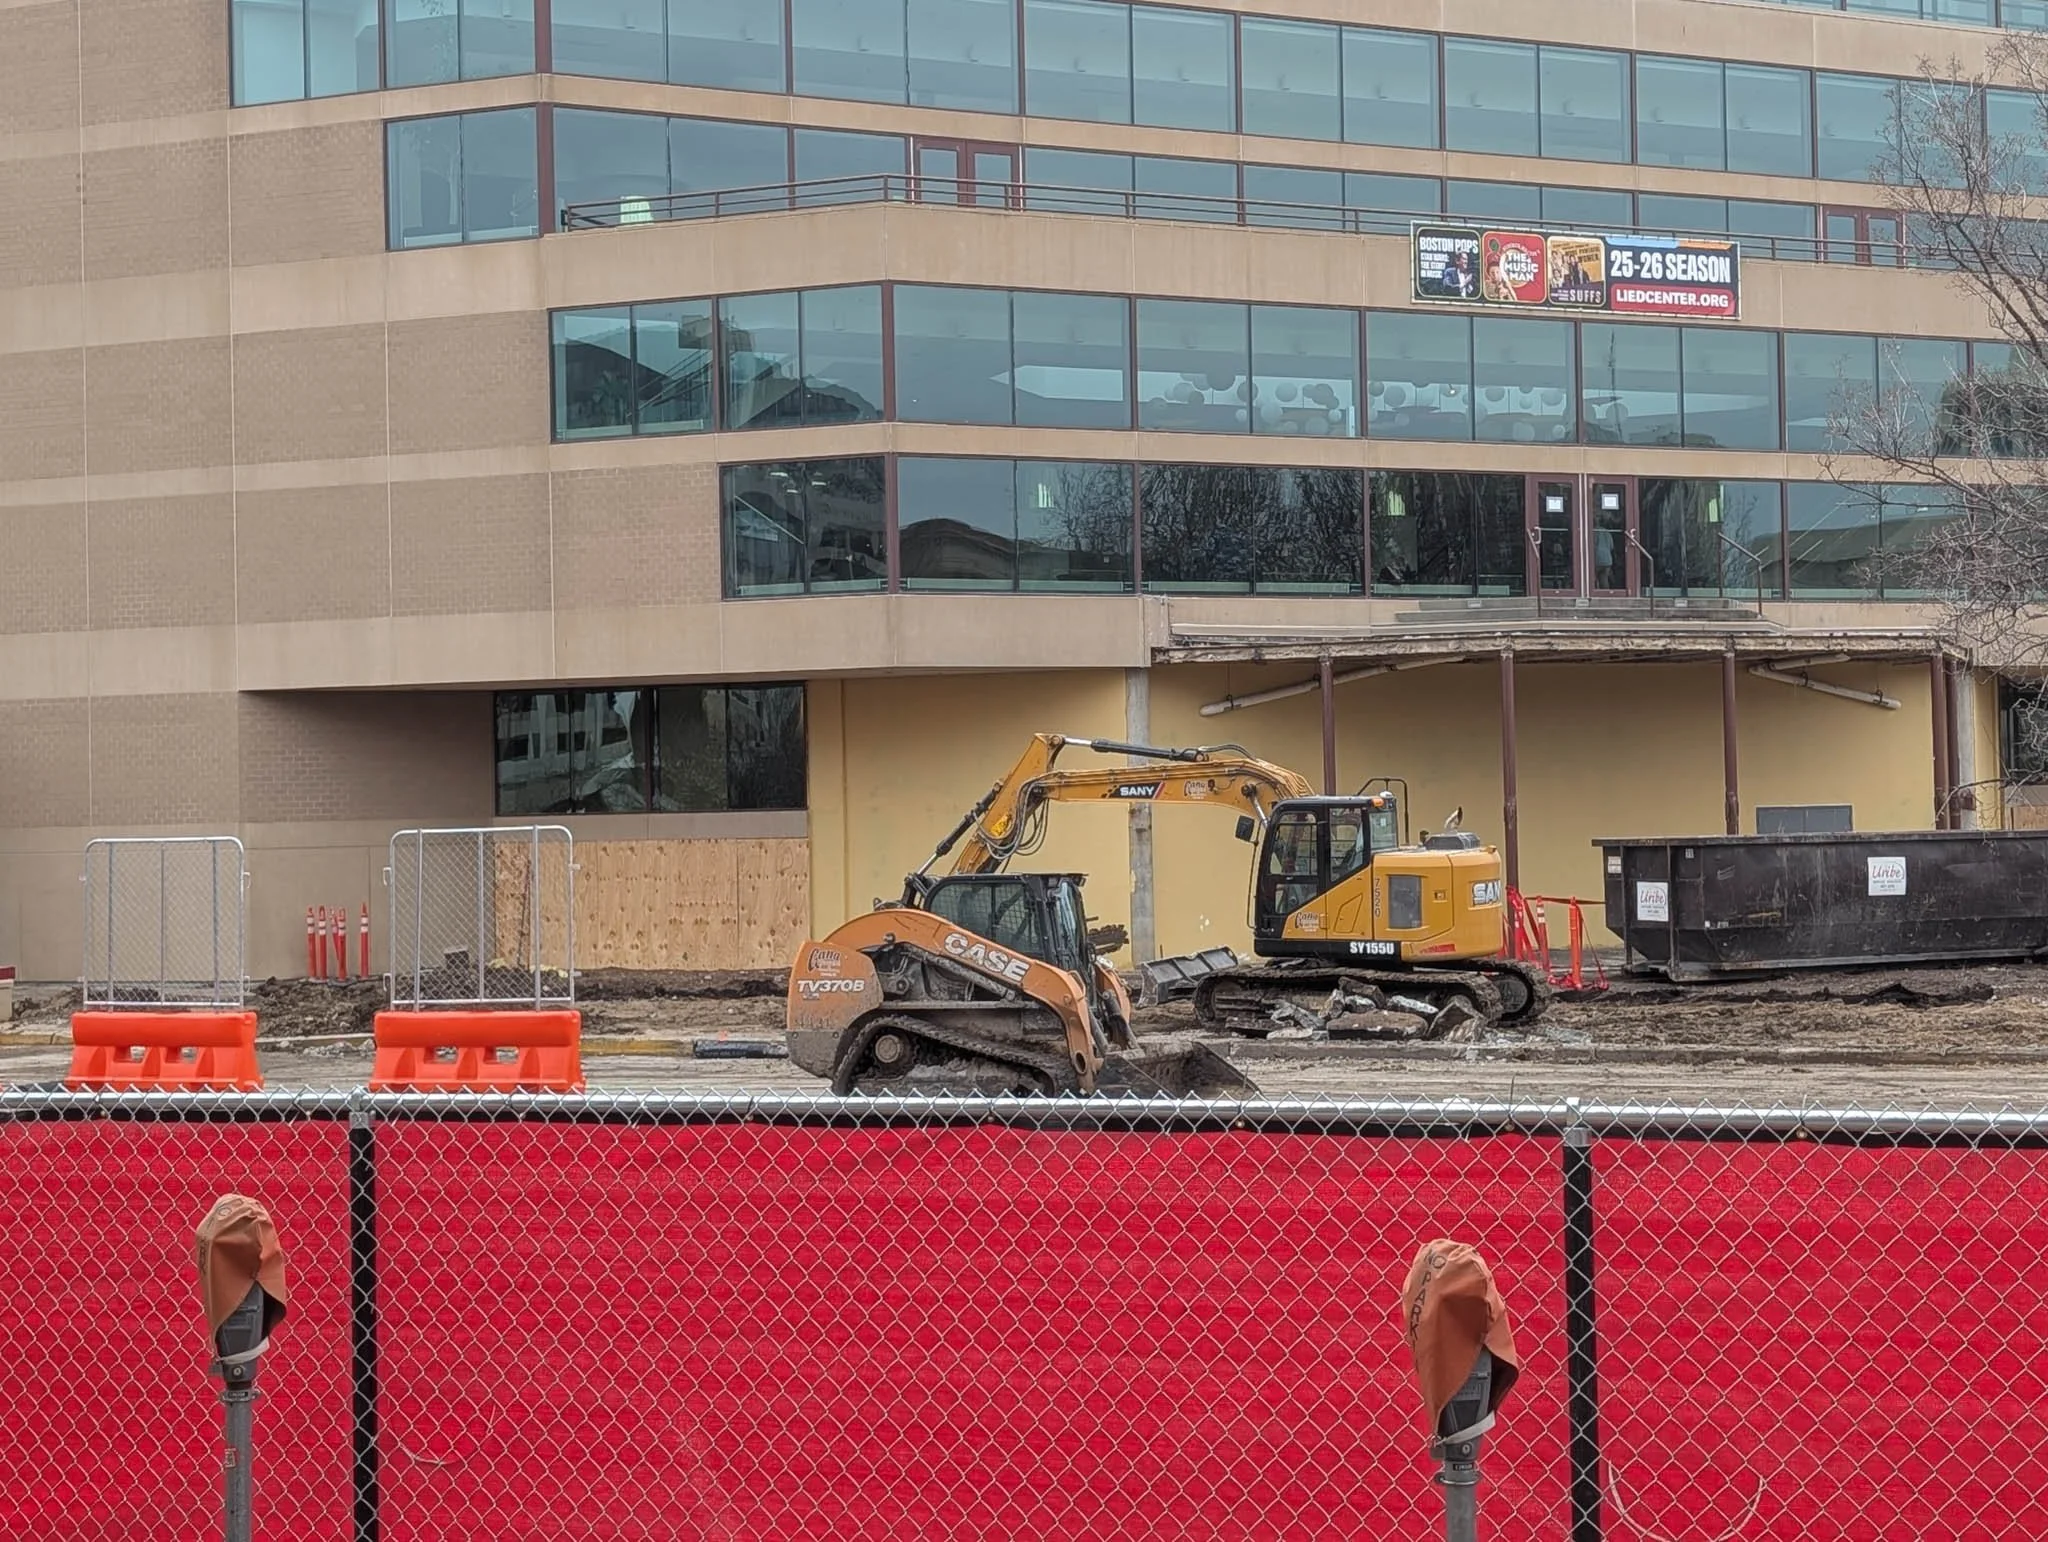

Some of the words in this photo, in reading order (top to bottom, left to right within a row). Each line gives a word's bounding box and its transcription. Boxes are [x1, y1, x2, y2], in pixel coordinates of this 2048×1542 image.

[1419, 237, 1454, 252] BOSTON
[1455, 239, 1478, 254] POPS
[1507, 252, 1527, 262] THE
[1504, 262, 1539, 272] MUSIC
[1610, 250, 1663, 280] 25-26
[1665, 253, 1731, 283] SEASON
[1509, 272, 1535, 281] MAN
[1569, 289, 1601, 303] SUFFS
[1616, 289, 1729, 308] LIEDCENTER.ORG
[1119, 786, 1155, 796] SANY
[1872, 863, 1902, 879] Uribe
[1640, 890, 1665, 904] Uribe
[1349, 941, 1395, 955] SY155U
[944, 932, 1030, 982] CASE
[797, 979, 865, 993] TV370B
[1423, 1247, 1446, 1269] NO
